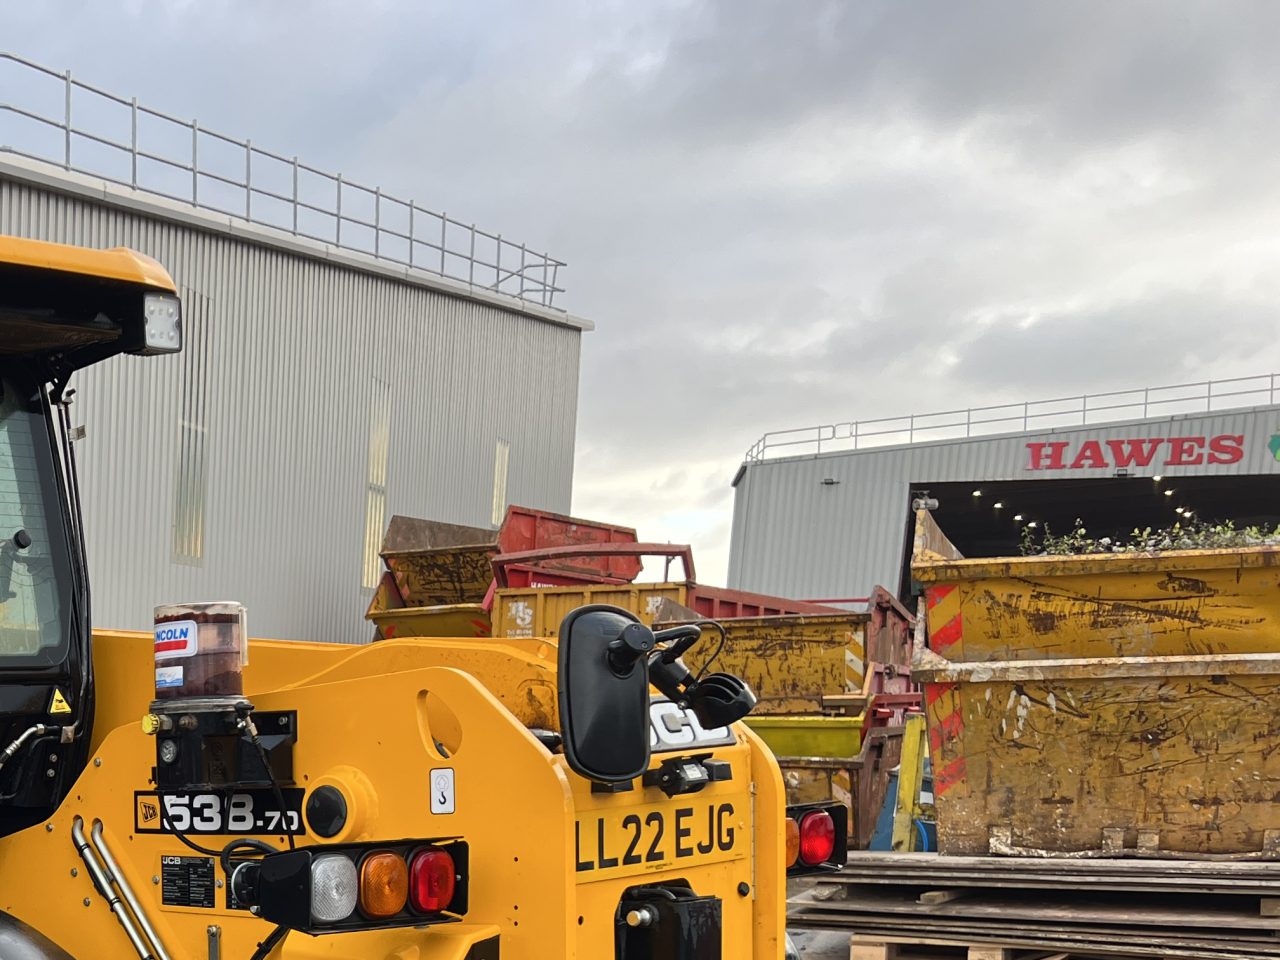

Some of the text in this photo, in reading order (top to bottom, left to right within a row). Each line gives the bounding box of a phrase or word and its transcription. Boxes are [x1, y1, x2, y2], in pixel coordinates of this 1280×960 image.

[1025, 434, 1245, 471] HAWES
[155, 627, 189, 642] NCOLN
[142, 803, 158, 820] JCB
[575, 802, 735, 873] LL22 EJG
[162, 856, 181, 865] JCB
